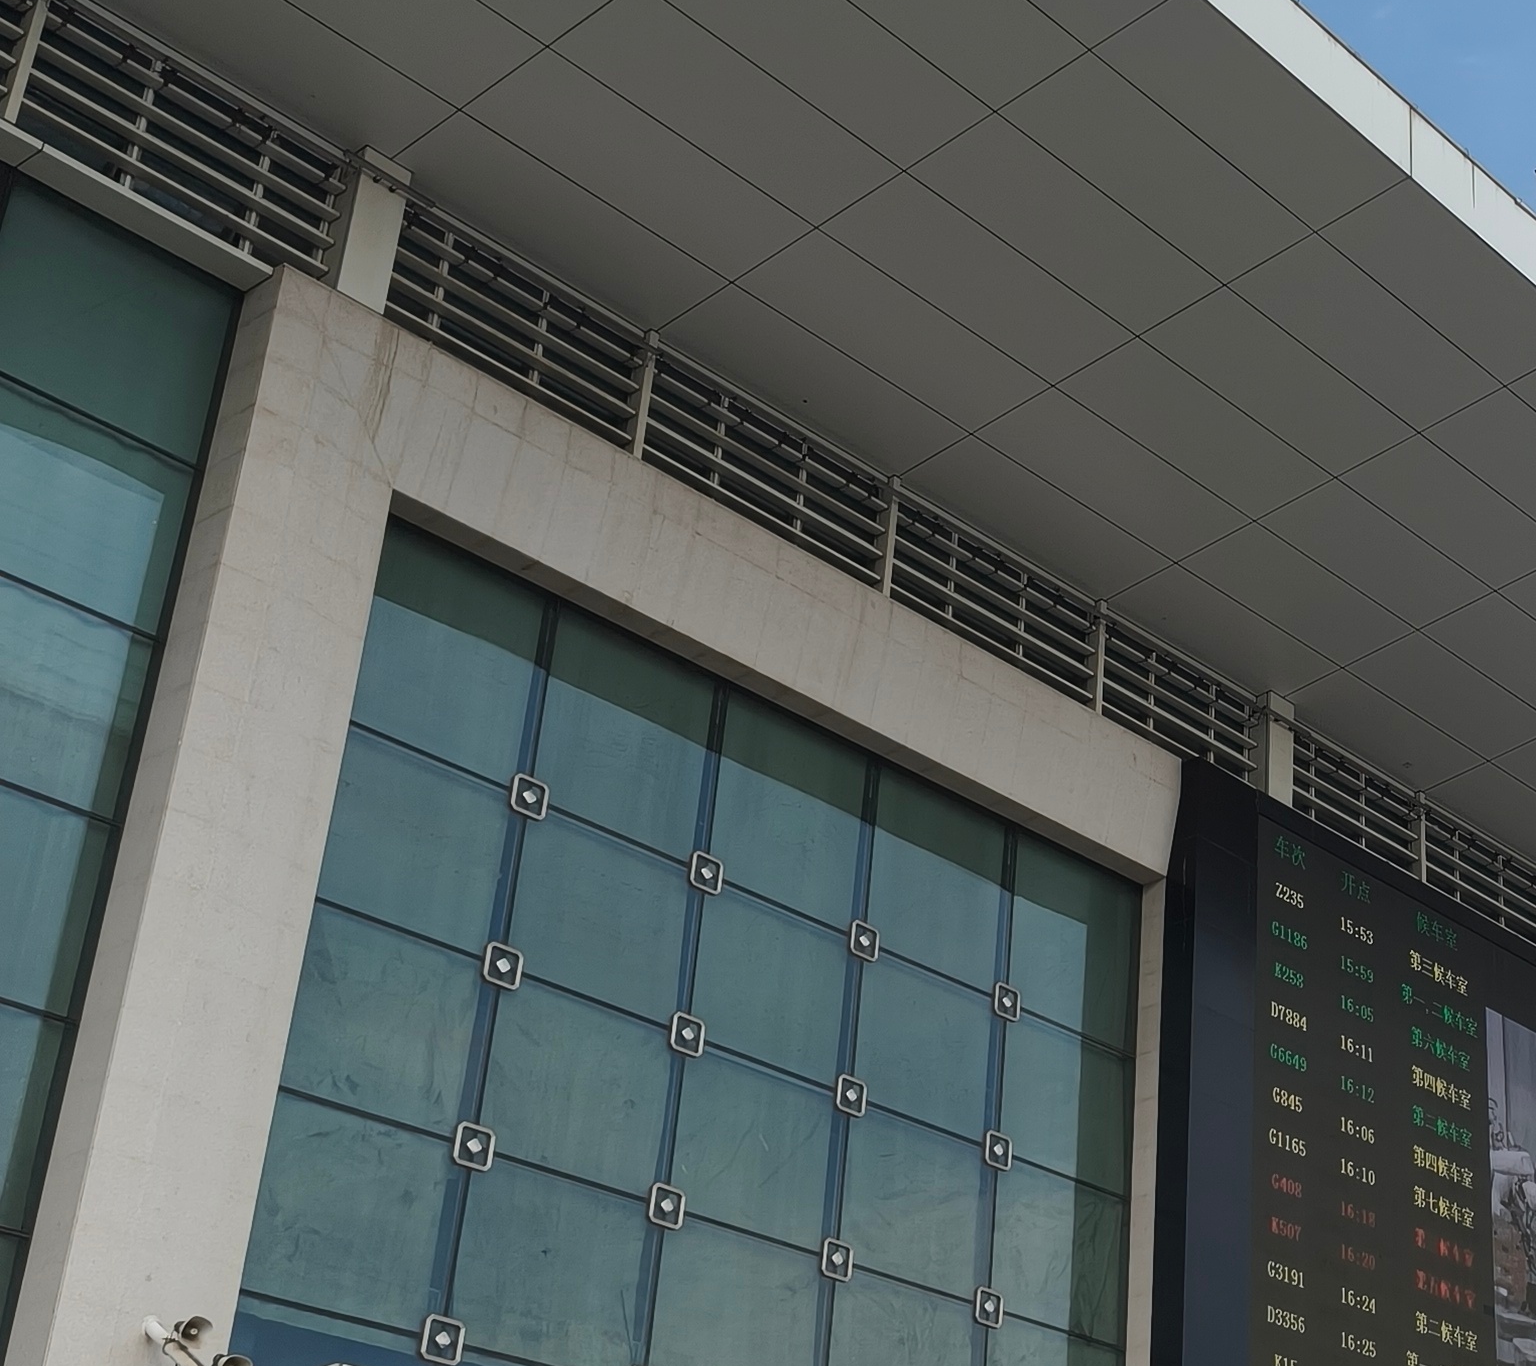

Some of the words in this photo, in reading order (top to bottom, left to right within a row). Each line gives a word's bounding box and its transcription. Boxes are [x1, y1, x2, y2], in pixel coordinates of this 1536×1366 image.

[1274, 836, 1306, 870] 车次
[1340, 871, 1371, 903] 开点
[1416, 911, 1459, 951] 候车室
[1275, 882, 1304, 909] Z235
[1340, 916, 1374, 944] 15:53
[1410, 950, 1468, 996] 第三候车室
[1272, 922, 1307, 950] G1186
[1340, 956, 1374, 983] 15:59
[1271, 1001, 1307, 1031] D7884
[1340, 1036, 1373, 1063] 16:11
[1411, 1065, 1471, 1110] 第四候车室
[1274, 962, 1304, 989] K258
[1340, 995, 1374, 1023] 16:05
[1411, 1026, 1470, 1071] 第六候车室
[1270, 1044, 1307, 1072] G6649
[1340, 1076, 1375, 1103] 16:12
[1412, 1105, 1472, 1149] 第二候车室
[1272, 1087, 1303, 1112] G845
[1340, 1117, 1375, 1144] 16:06
[1413, 1145, 1474, 1189] 第四候车室
[1269, 1128, 1306, 1156] G1165
[1340, 1158, 1375, 1186] 16:10
[1414, 1186, 1474, 1228] 第七候车室
[1340, 1201, 1375, 1227] 16:18
[1271, 1217, 1301, 1241] K507
[1340, 1244, 1375, 1271] 16:20
[1267, 1260, 1305, 1289] G3191
[1340, 1287, 1376, 1314] 16:24
[1415, 1311, 1477, 1353] 第二候车室
[1267, 1305, 1305, 1333] D3356
[1340, 1332, 1376, 1358] 16:25
